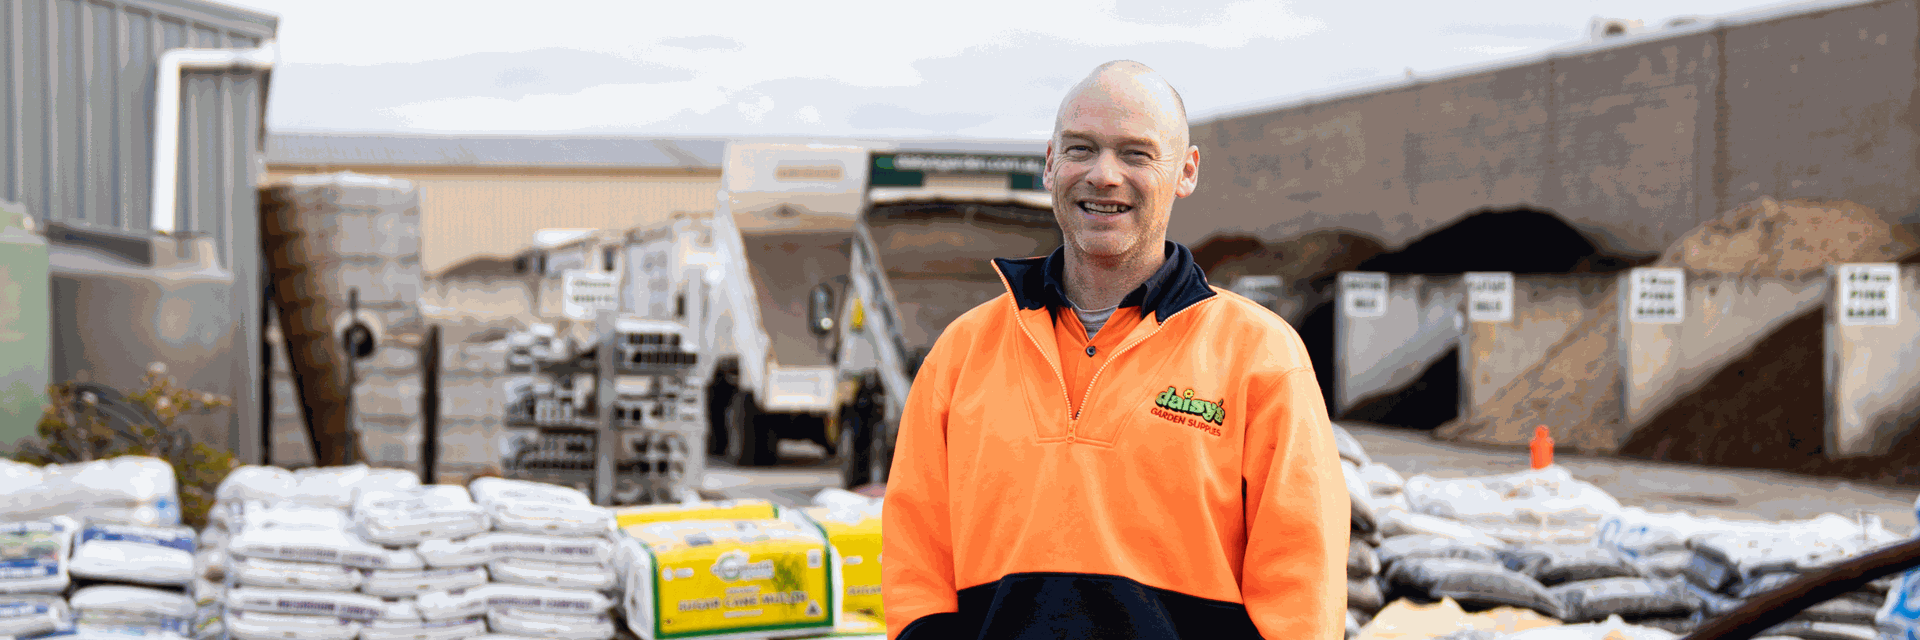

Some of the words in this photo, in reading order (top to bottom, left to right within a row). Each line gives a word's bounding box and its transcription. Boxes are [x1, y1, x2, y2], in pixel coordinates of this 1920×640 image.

[1150, 407, 1187, 425] GARDEN
[1187, 418, 1222, 437] SUPPLIES
[1155, 386, 1226, 426] daisy's
